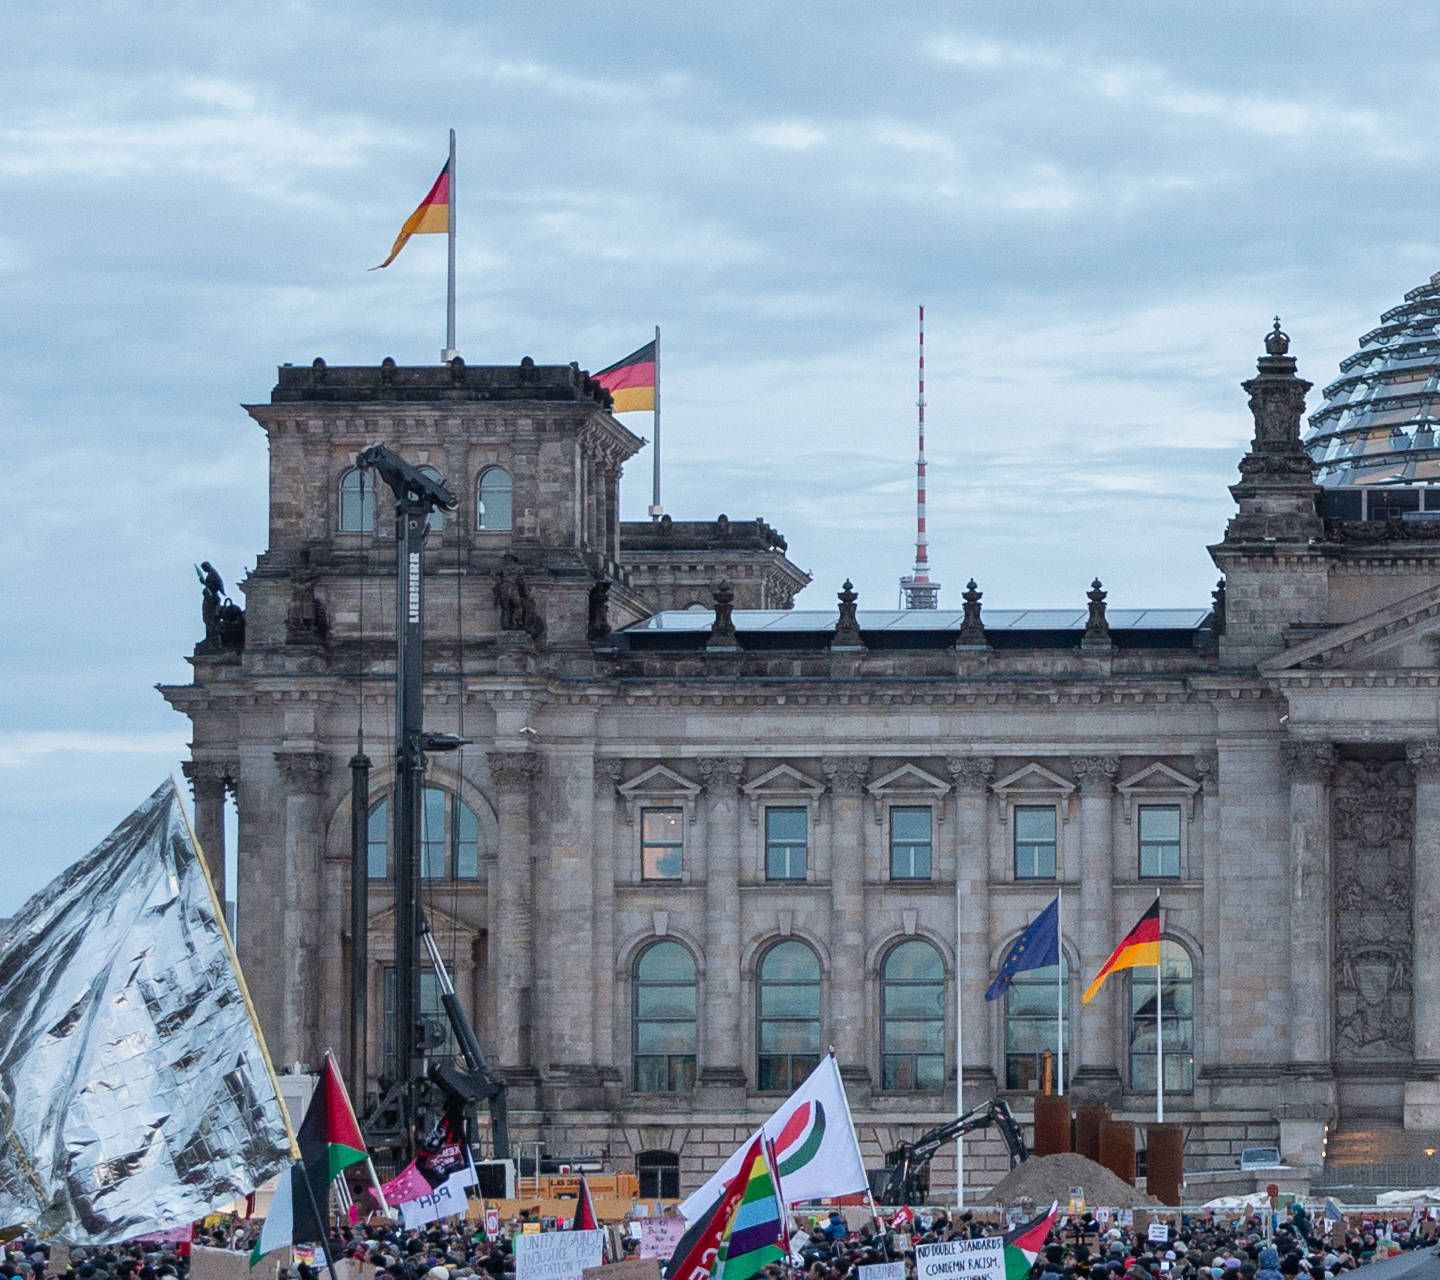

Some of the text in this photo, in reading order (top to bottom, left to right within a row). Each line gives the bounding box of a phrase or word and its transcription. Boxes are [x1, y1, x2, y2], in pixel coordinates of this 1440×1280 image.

[526, 1231, 602, 1250] UNITY AGAINST
[918, 1238, 1001, 1258] NO DOUBLE STANDARDS
[926, 1256, 1000, 1276] CONDEMN RACISM,
